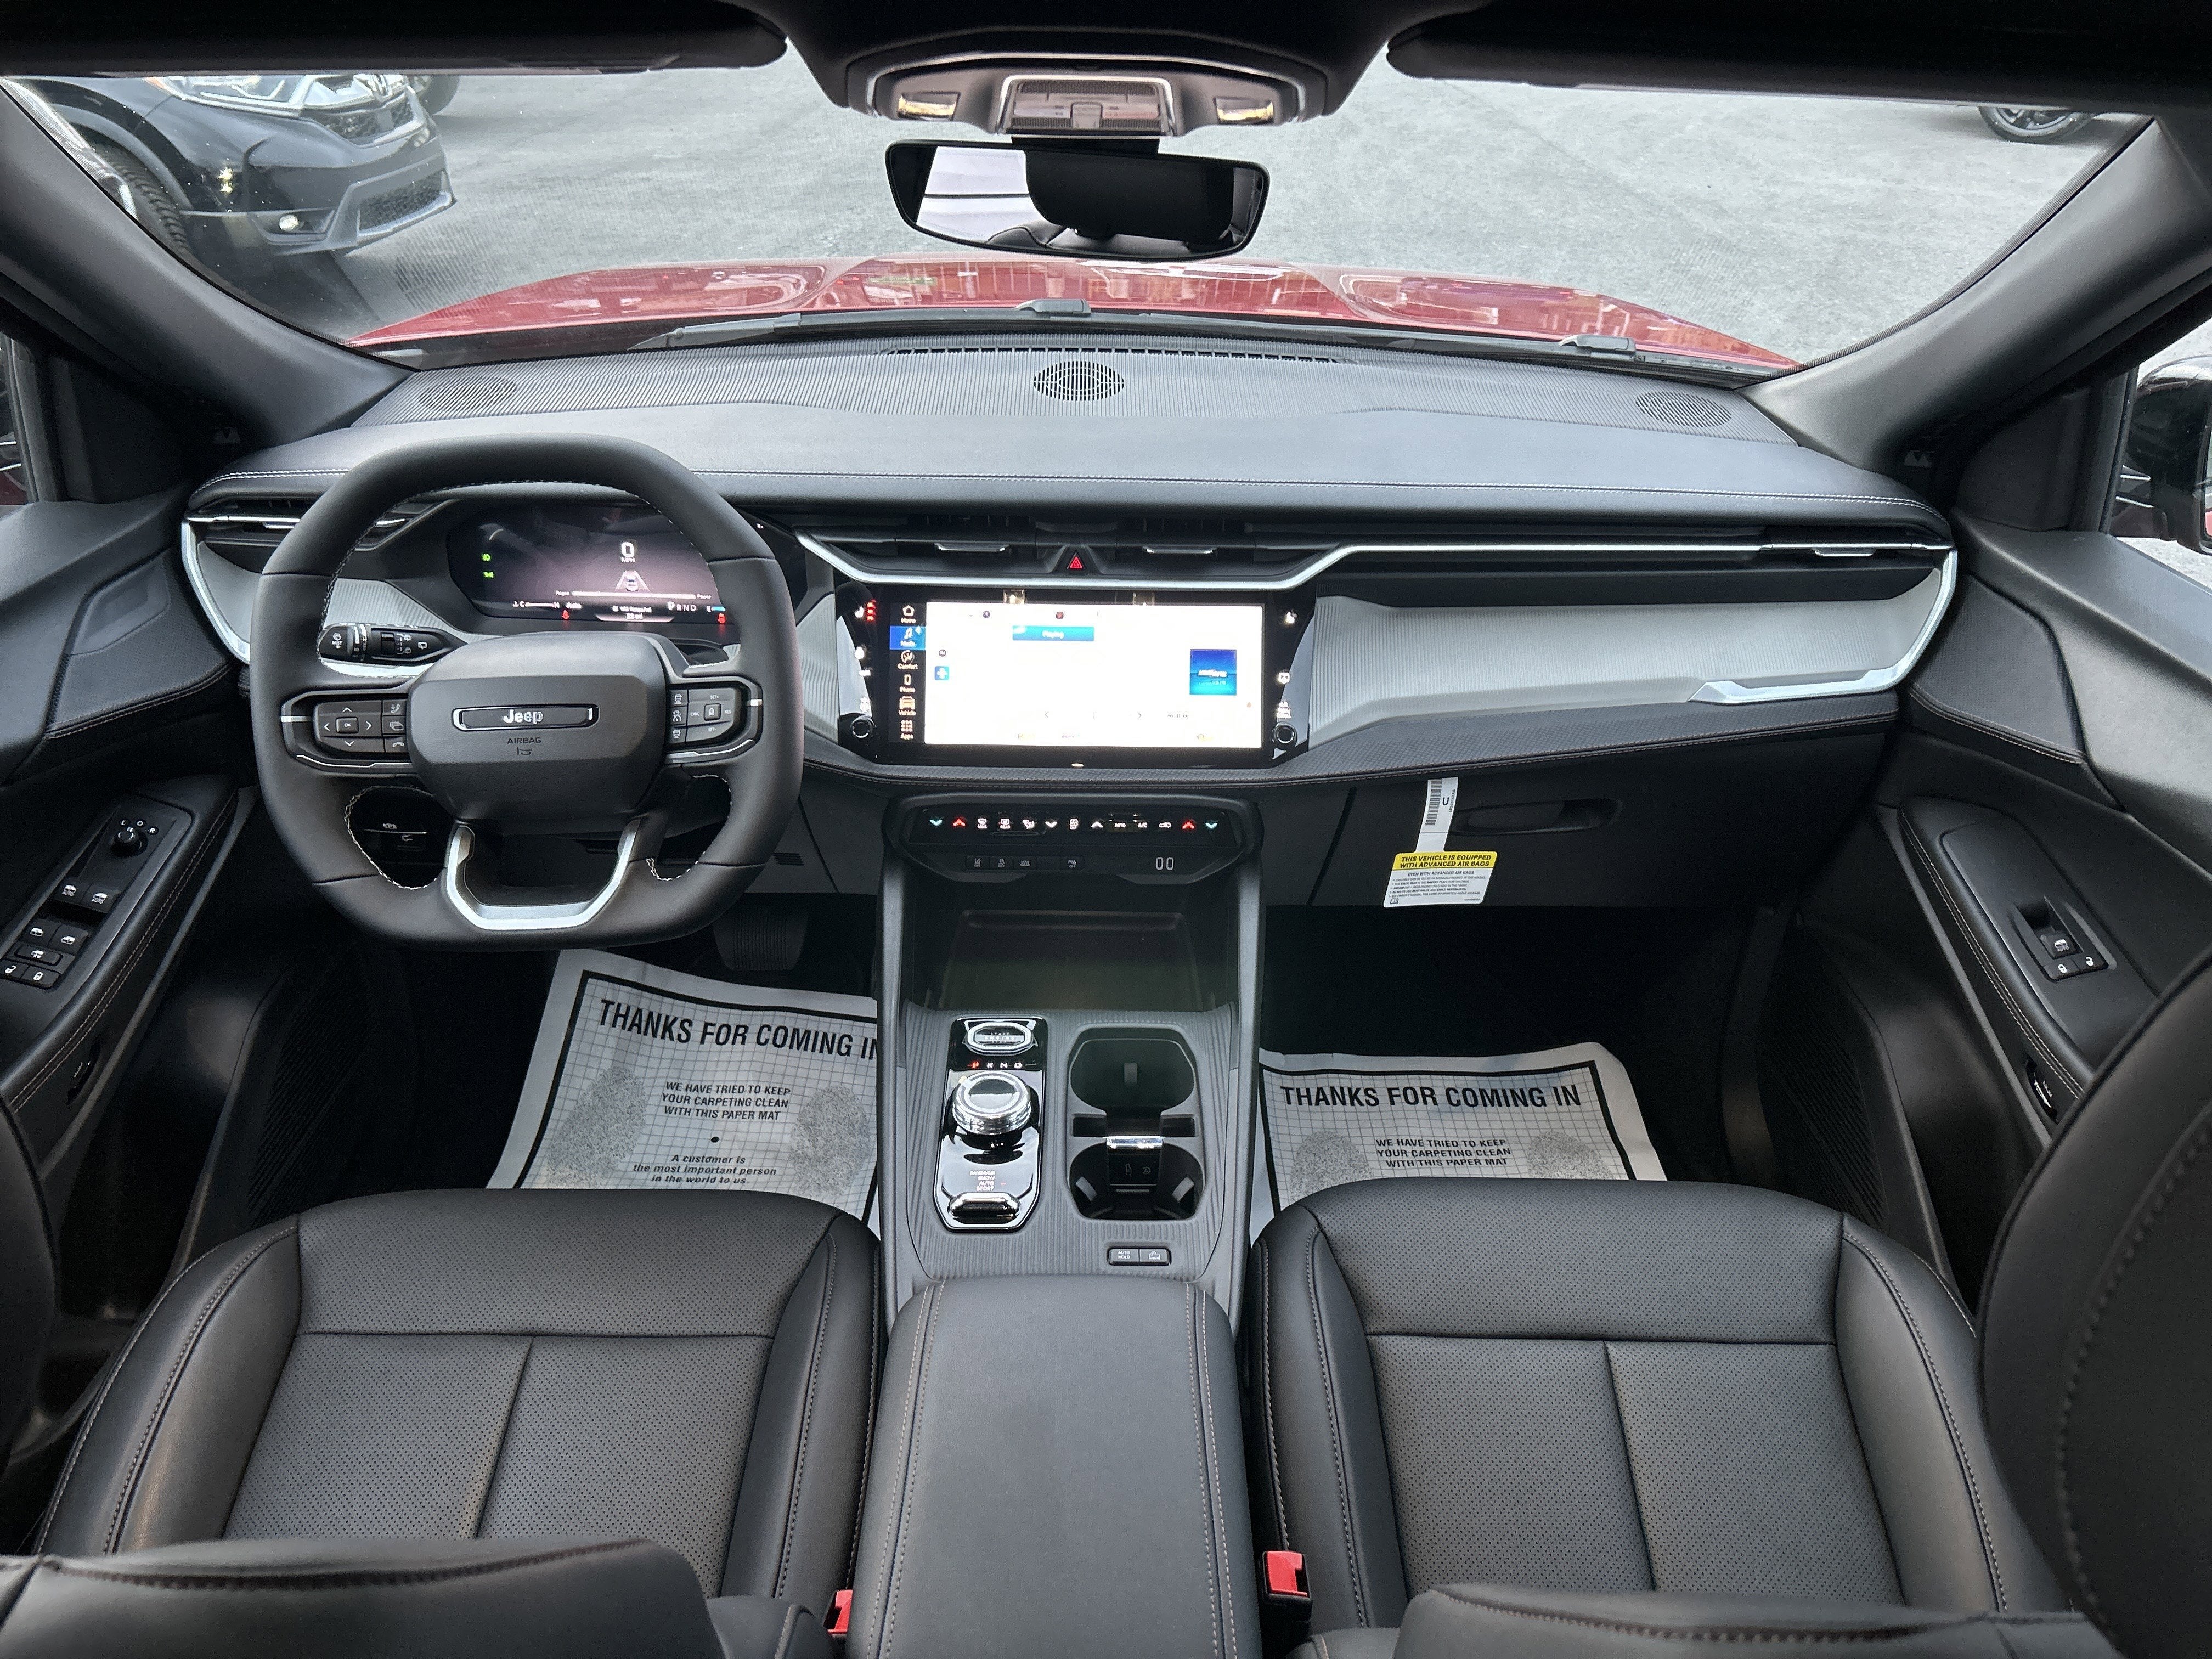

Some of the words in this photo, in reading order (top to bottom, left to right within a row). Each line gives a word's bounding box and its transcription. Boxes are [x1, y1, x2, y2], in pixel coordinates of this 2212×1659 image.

[622, 541, 634, 557] 0
[668, 601, 675, 610] P
[503, 709, 544, 724] Jeep
[1443, 797, 1449, 805] U
[600, 999, 693, 1043] THANKS
[699, 1021, 749, 1046] FOR
[756, 1024, 853, 1057] COMING
[666, 1081, 683, 1091] WE
[685, 1084, 713, 1093] HAVE
[715, 1085, 744, 1094] TRIED
[748, 1085, 761, 1094] TO
[764, 1086, 791, 1096] KEEP
[662, 1092, 691, 1104] YOUR
[694, 1097, 752, 1107] CARPETING
[755, 1098, 788, 1108] CLEAN
[1280, 1086, 1380, 1107] THANKS
[1387, 1086, 1438, 1105] FOR
[1445, 1087, 1547, 1107] COMING
[1552, 1084, 1581, 1106] IN
[664, 1105, 691, 1116] WITH
[696, 1108, 719, 1119] THIS
[721, 1110, 755, 1120] PAPER
[758, 1111, 781, 1120] MAT
[1397, 1138, 1424, 1147] HAVE
[1426, 1139, 1459, 1148] TRIED
[1479, 1139, 1506, 1147] KEEP
[682, 1155, 733, 1164] customer
[1377, 1149, 1408, 1158] YOUR
[1411, 1149, 1472, 1158] CARPETING
[1476, 1148, 1511, 1156] CLEAN
[1385, 1159, 1415, 1167] WITH
[633, 1164, 650, 1172] the
[653, 1165, 681, 1173] most
[684, 1165, 737, 1175] important
[739, 1167, 777, 1176] person
